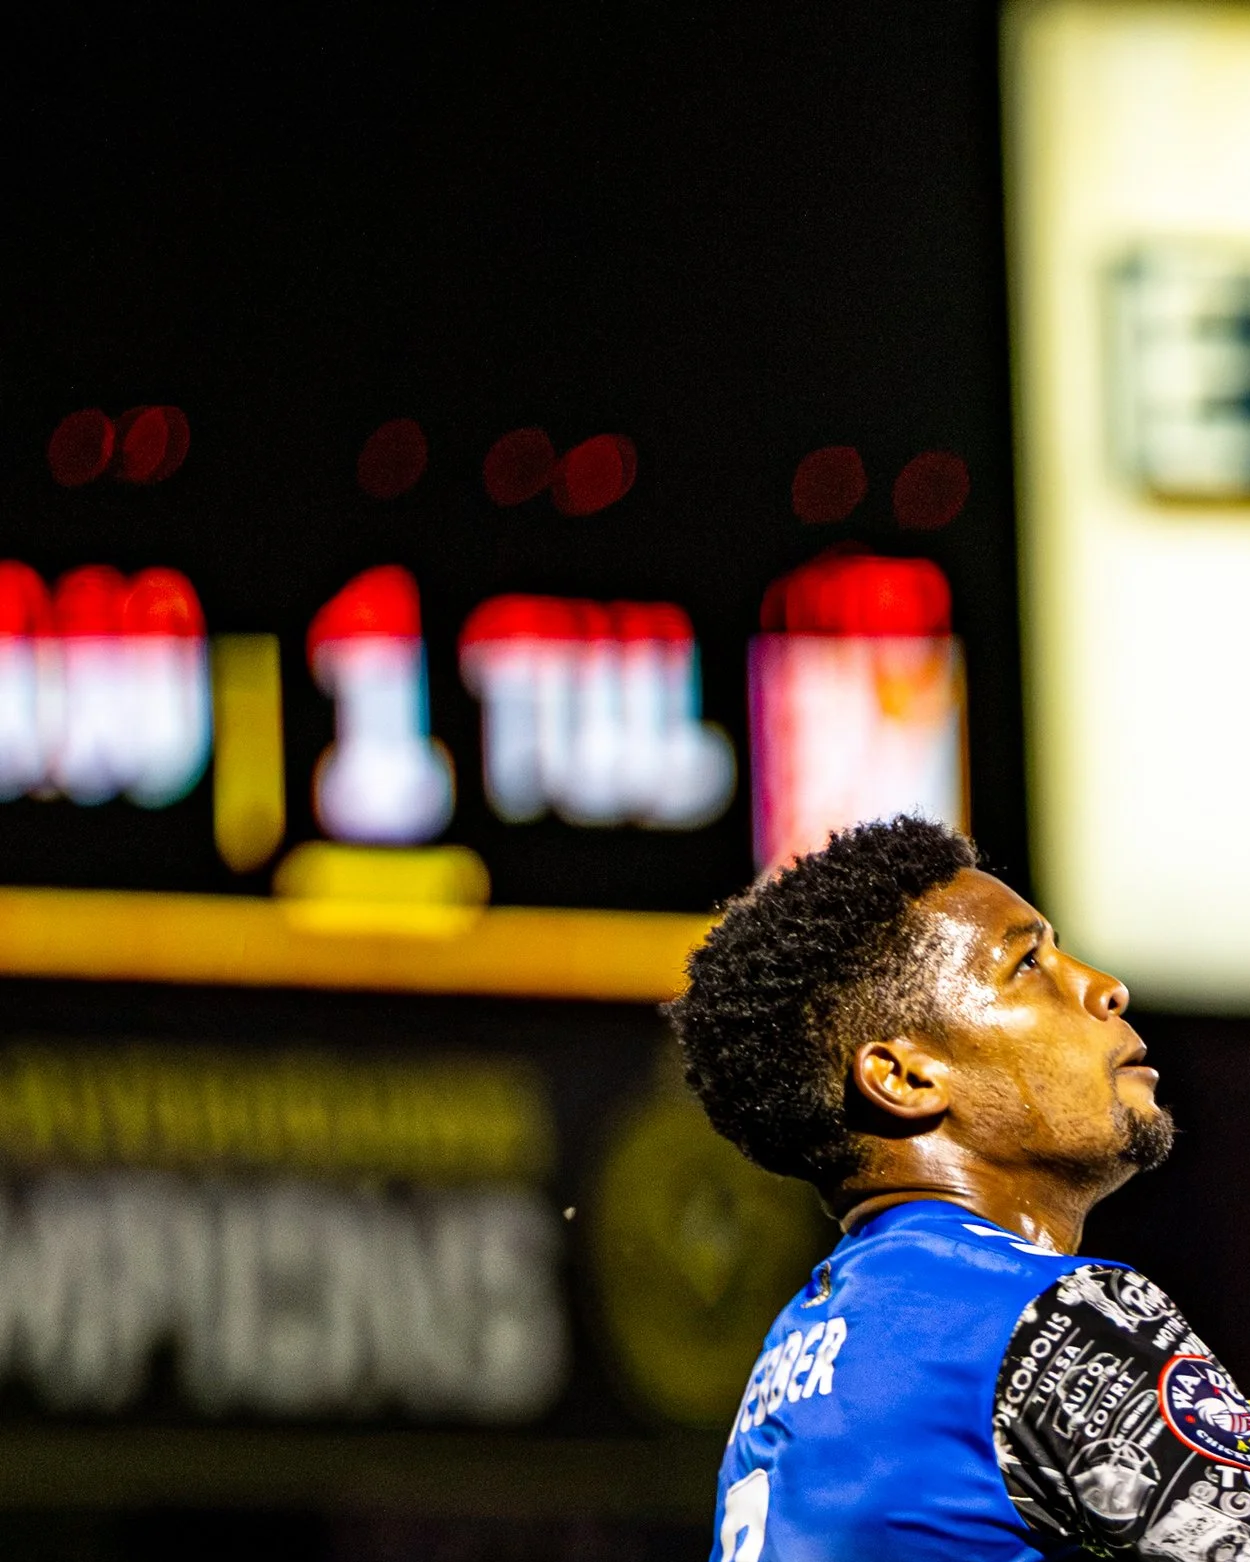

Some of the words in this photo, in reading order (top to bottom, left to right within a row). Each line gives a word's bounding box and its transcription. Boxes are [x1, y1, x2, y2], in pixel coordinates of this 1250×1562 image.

[993, 1312, 1073, 1428] DECOPOLIS
[1032, 1345, 1082, 1405] TULSA
[1062, 1362, 1105, 1416] AUTO
[1084, 1371, 1134, 1438] COURT
